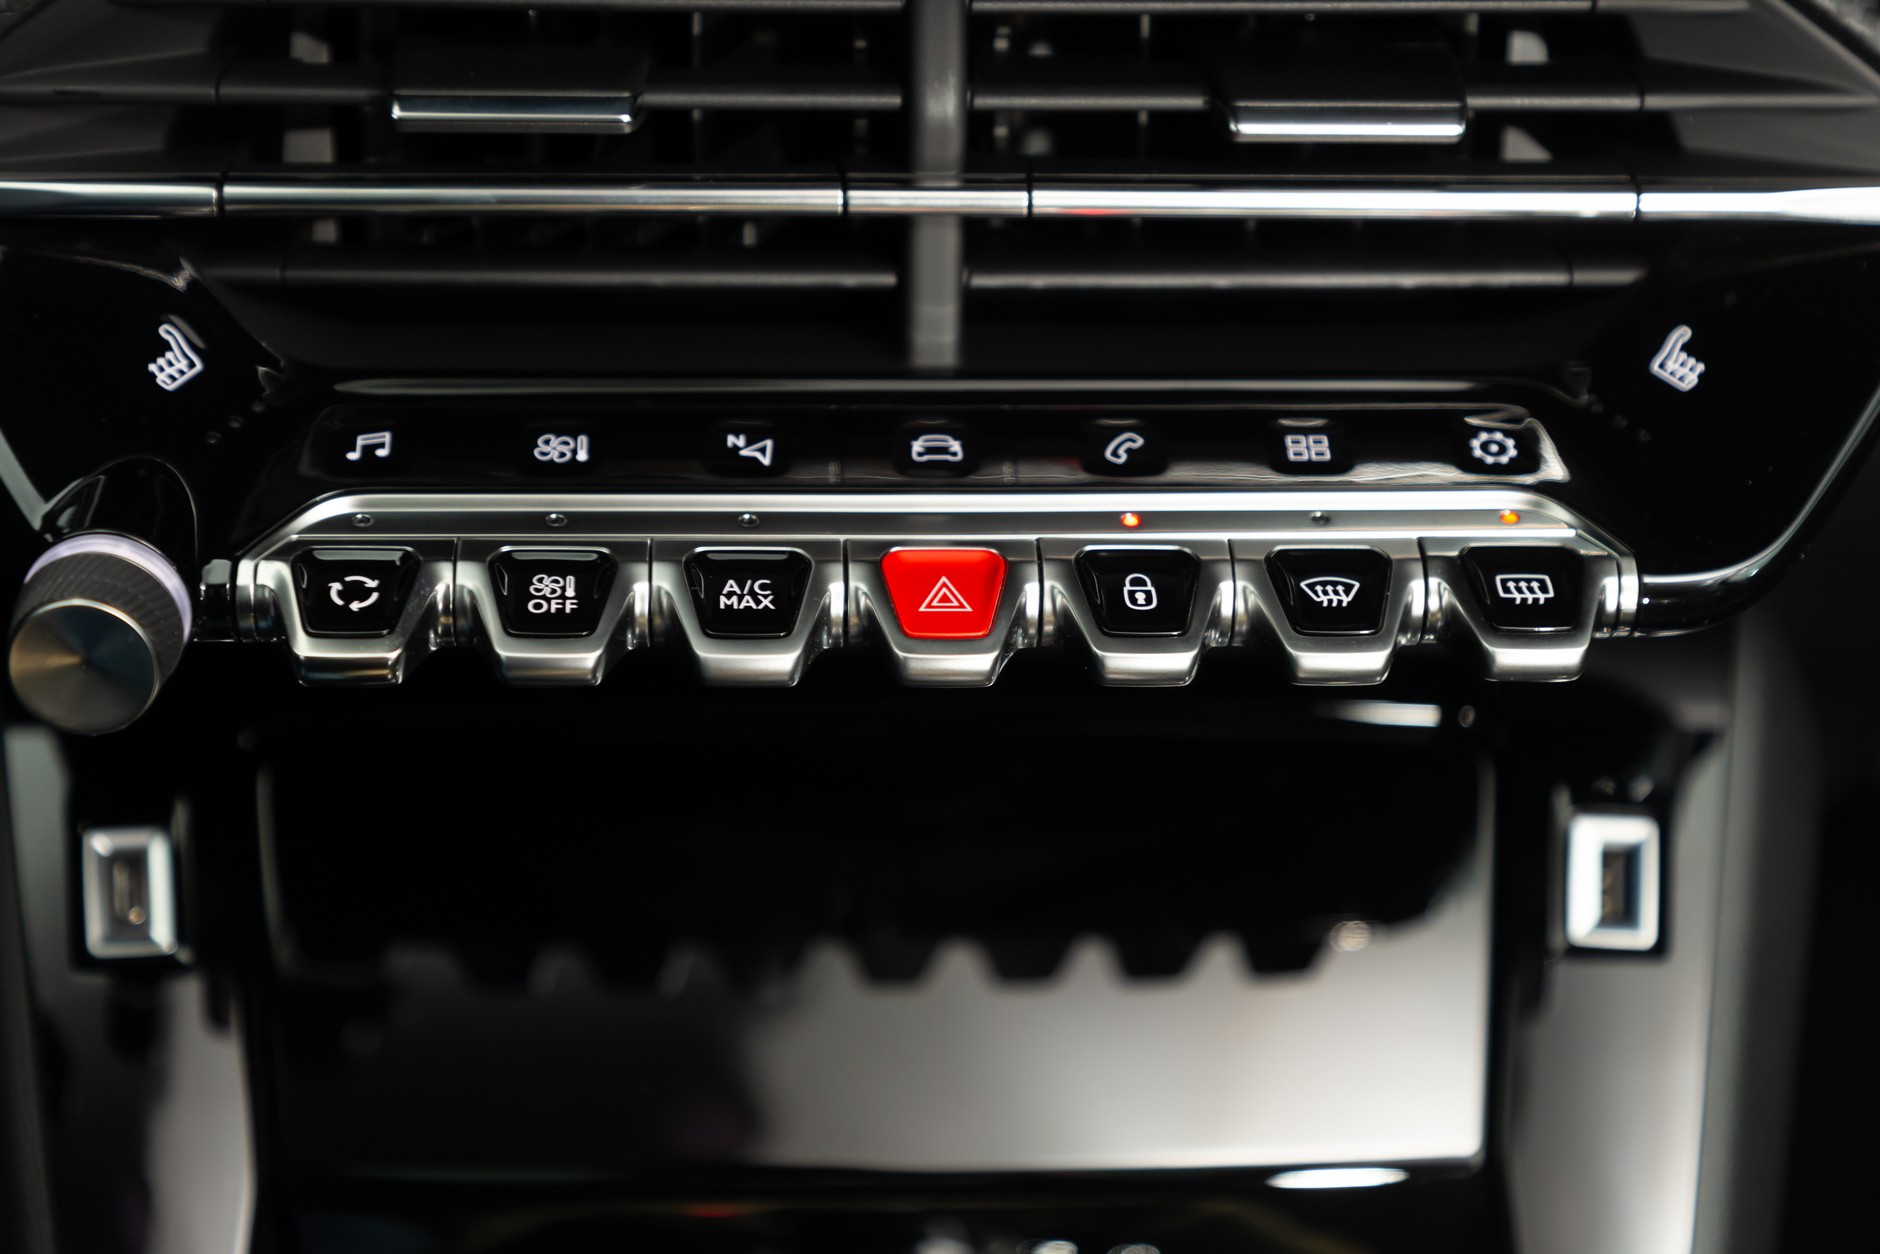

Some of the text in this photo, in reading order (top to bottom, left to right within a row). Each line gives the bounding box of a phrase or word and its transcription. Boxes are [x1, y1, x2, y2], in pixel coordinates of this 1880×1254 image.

[726, 434, 746, 448] N
[721, 579, 772, 595] A/C
[527, 599, 579, 614] OFF
[719, 595, 776, 610] MAX
